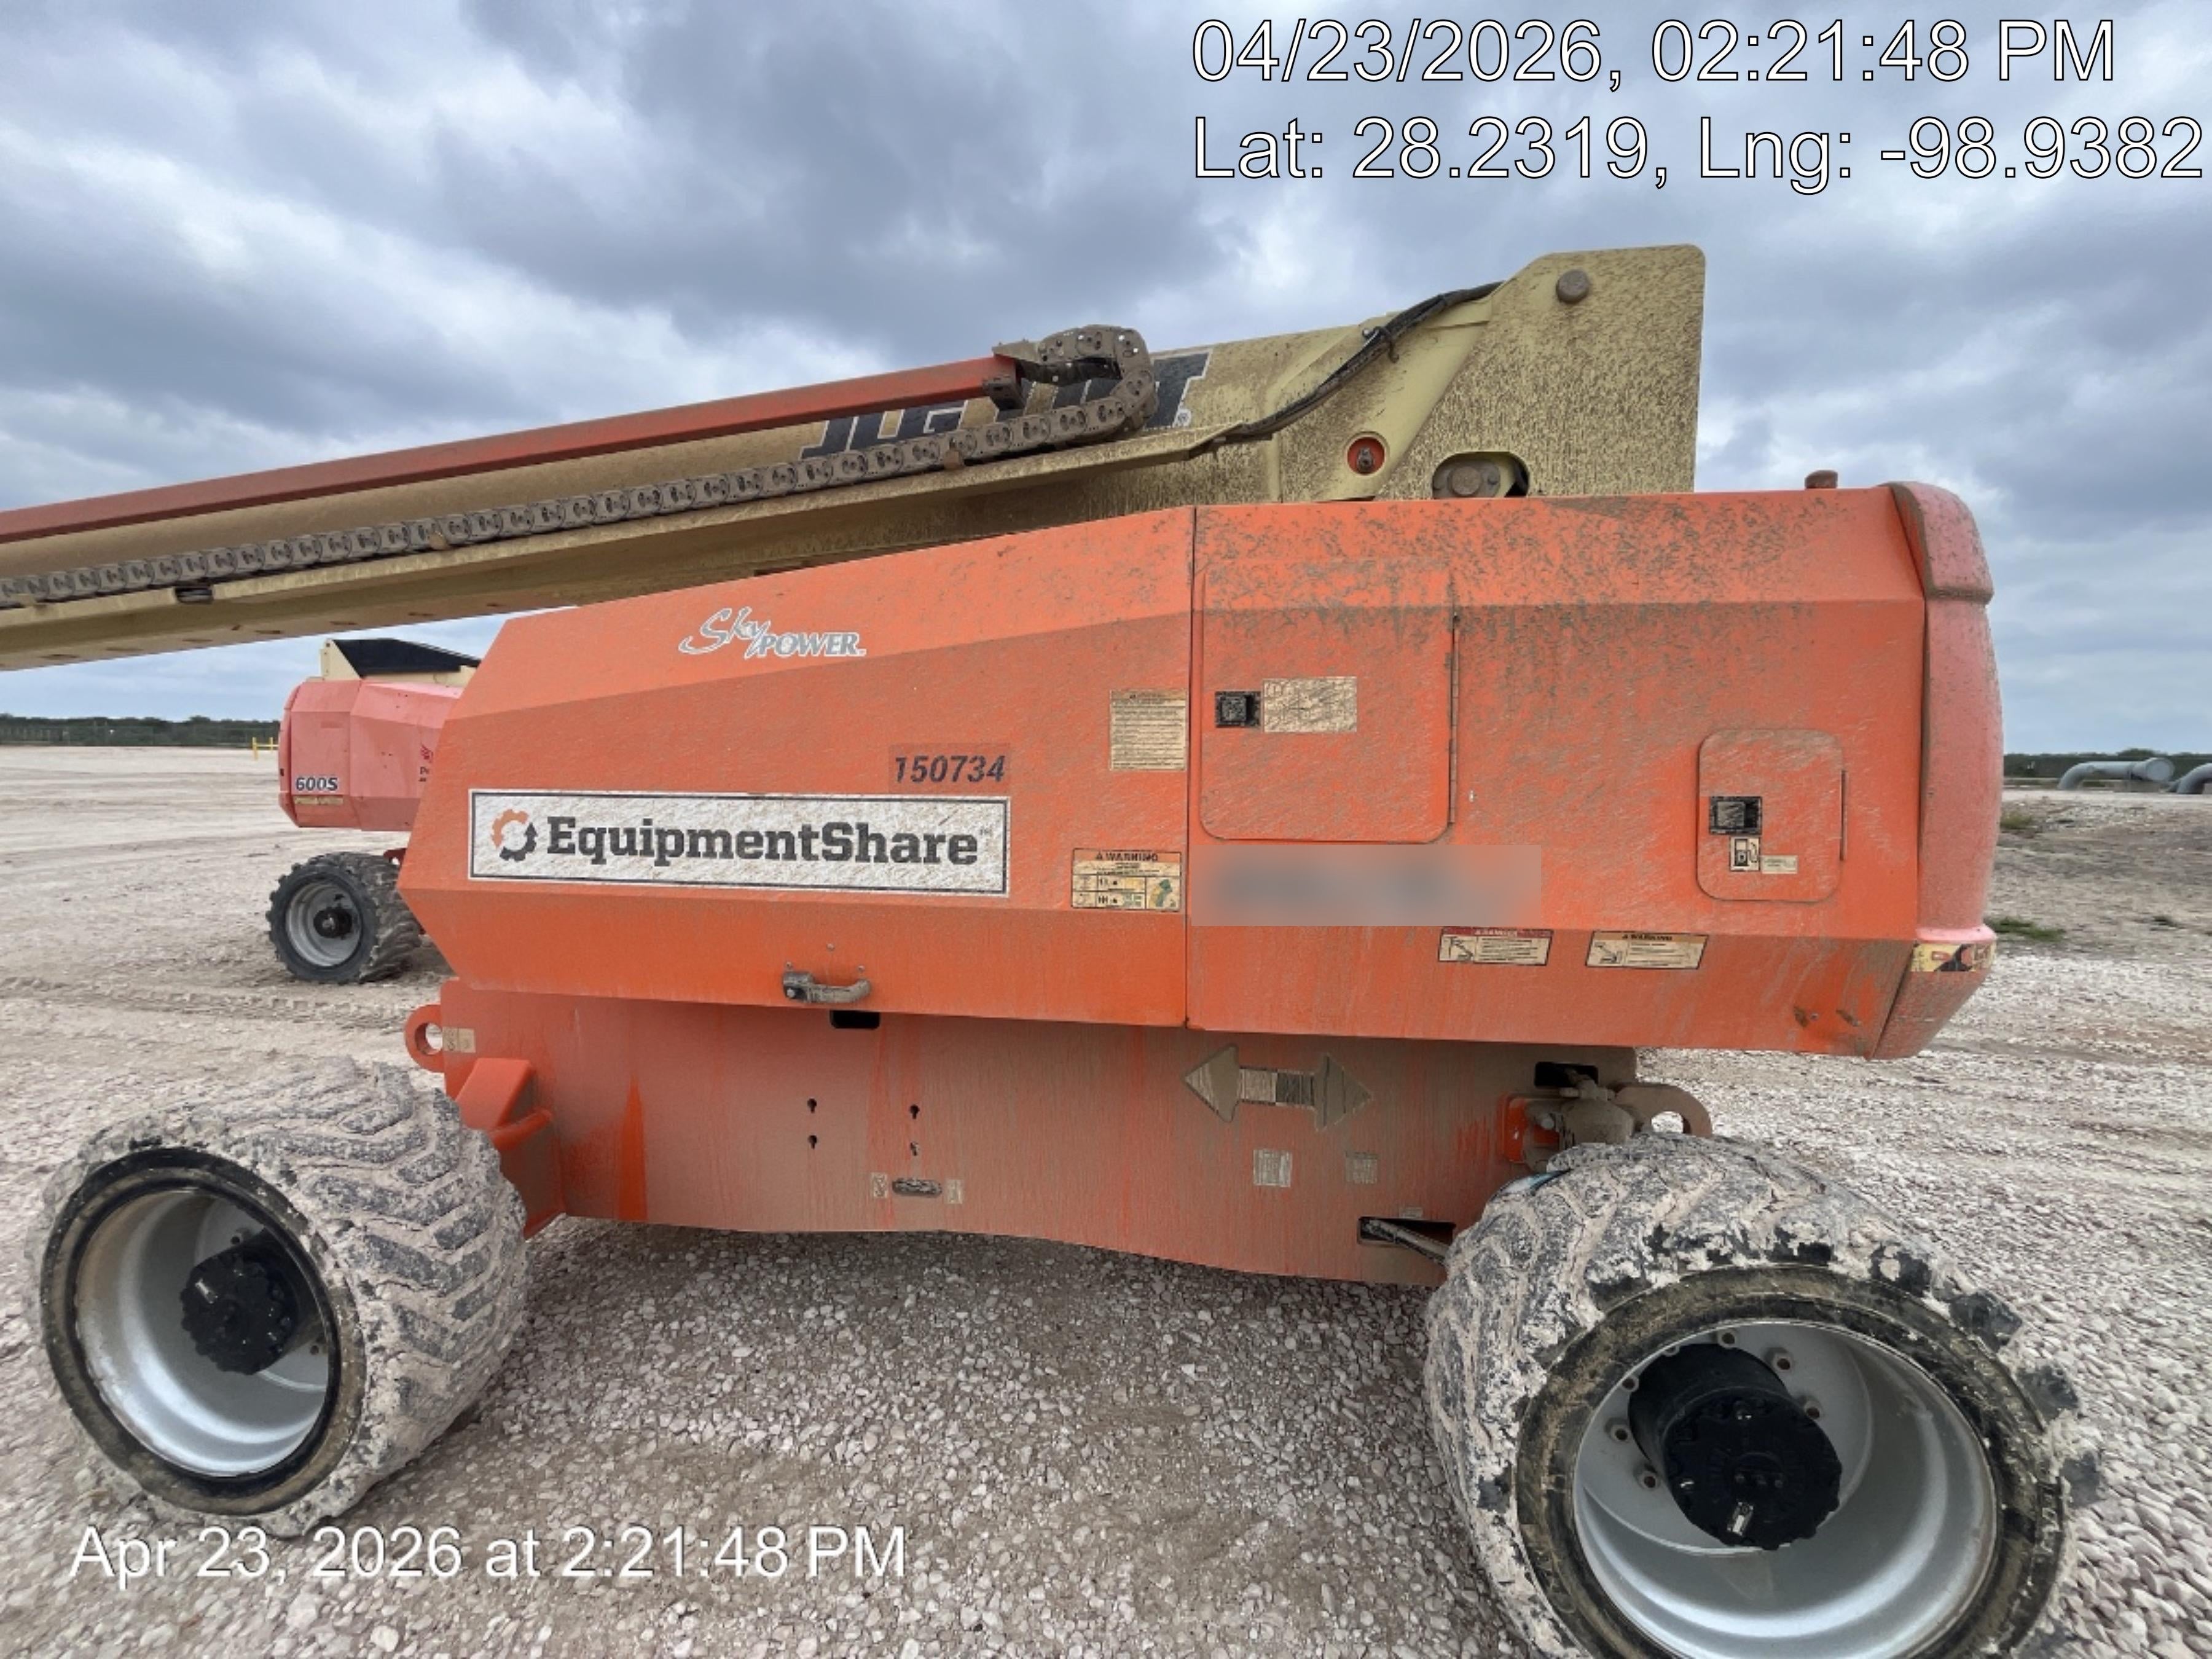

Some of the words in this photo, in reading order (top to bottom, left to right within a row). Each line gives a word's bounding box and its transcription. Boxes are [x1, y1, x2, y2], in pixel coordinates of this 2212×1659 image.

[678, 606, 771, 659] Sky
[296, 777, 338, 791] 600S
[895, 755, 1005, 783] 150734
[546, 816, 978, 866] EquipmentShare
